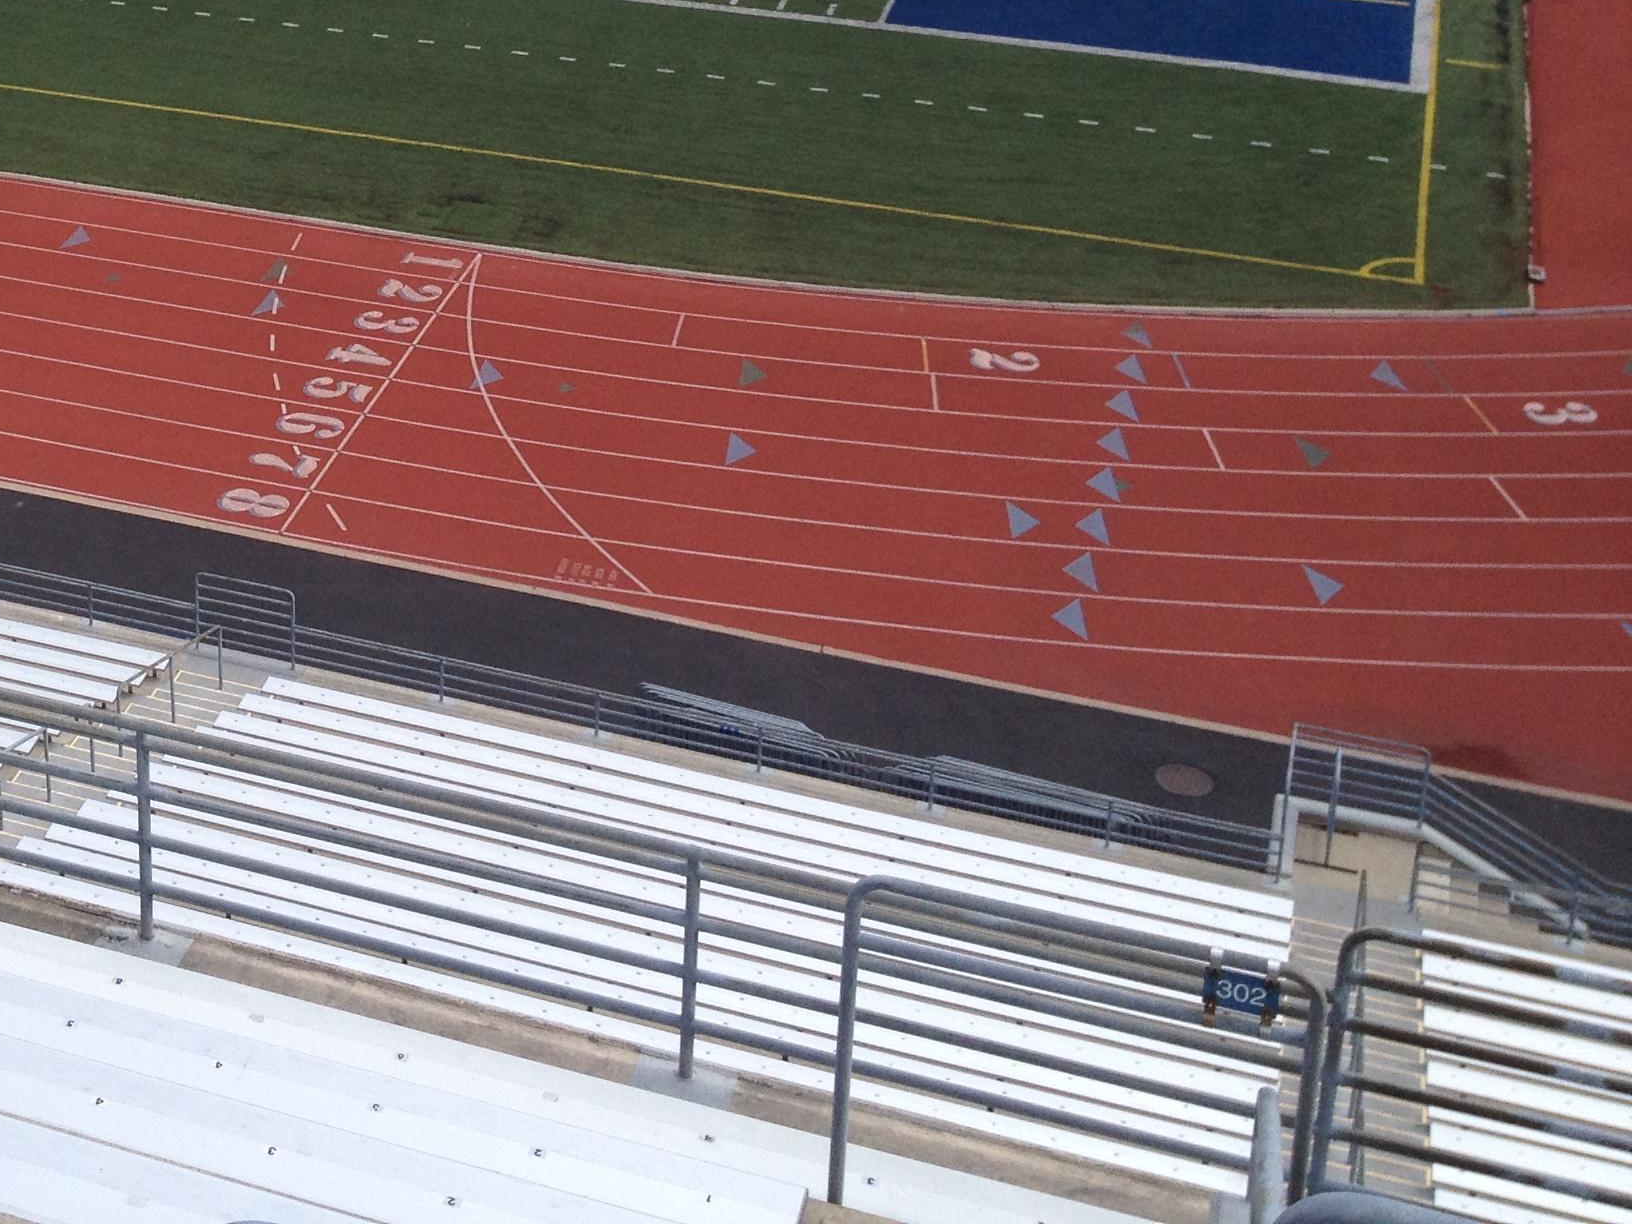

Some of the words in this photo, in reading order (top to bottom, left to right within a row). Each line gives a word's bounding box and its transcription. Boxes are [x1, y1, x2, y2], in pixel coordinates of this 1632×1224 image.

[401, 252, 464, 269] 1
[377, 278, 443, 303] 2
[354, 310, 420, 334] 3
[325, 343, 392, 367] 4
[969, 347, 1041, 373] 2
[303, 376, 374, 403] 5
[276, 412, 345, 439] 6
[1523, 401, 1598, 426] 3
[249, 452, 320, 478] 7
[217, 487, 290, 519] 8
[1216, 978, 1268, 1008] 302
